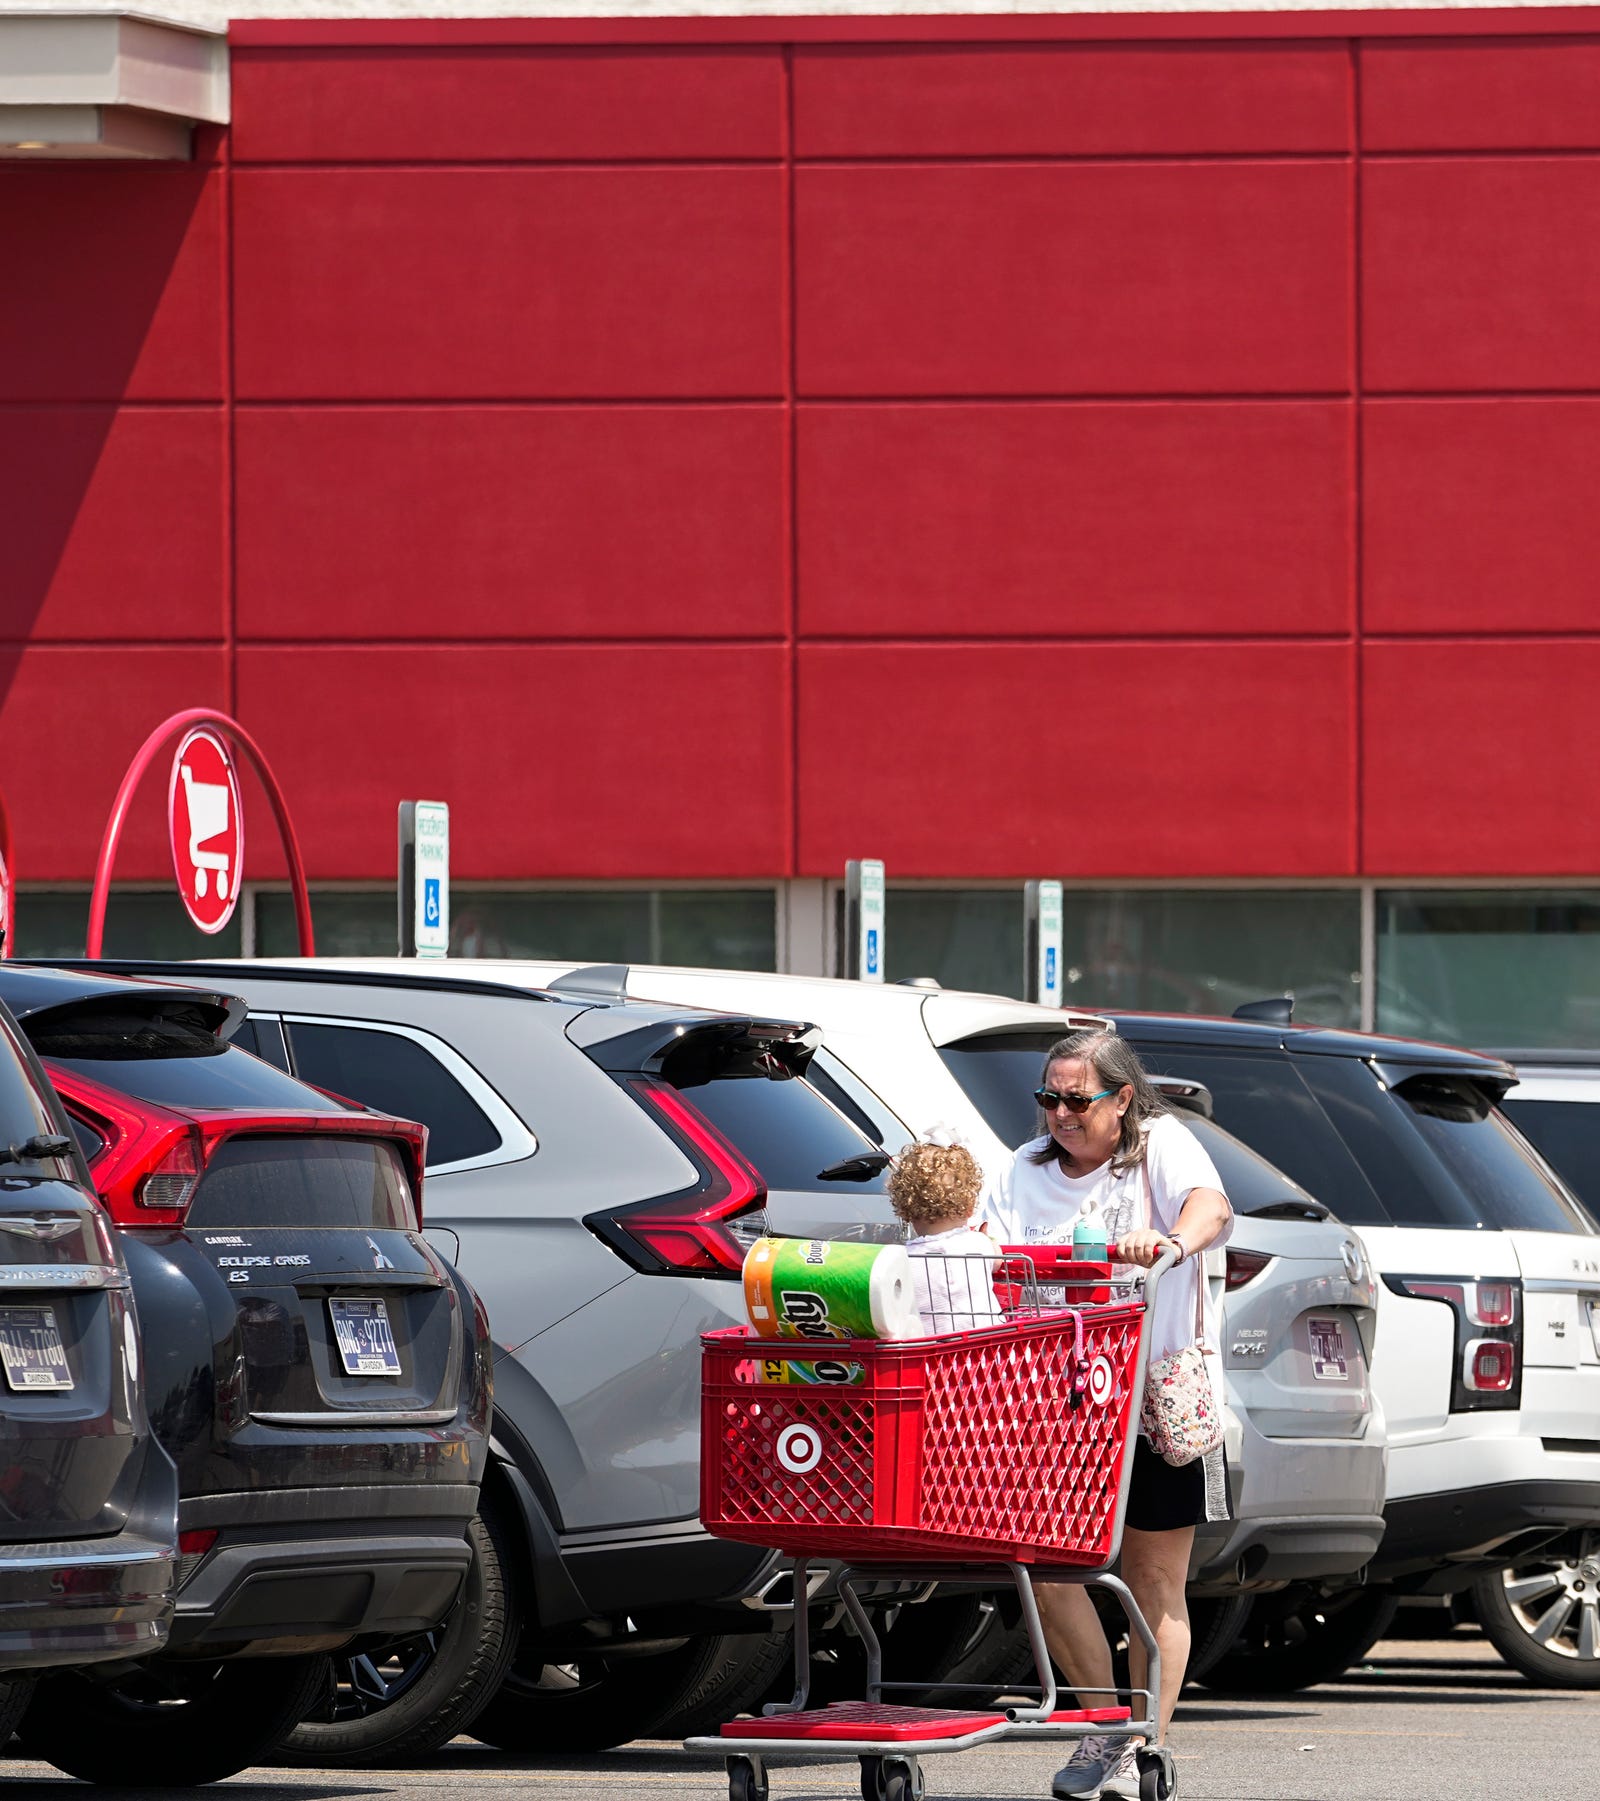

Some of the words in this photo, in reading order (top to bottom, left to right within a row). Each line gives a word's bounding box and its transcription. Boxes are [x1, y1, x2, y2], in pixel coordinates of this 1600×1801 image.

[218, 1256, 272, 1267] ECLIPSE
[274, 1254, 312, 1266] CROSS
[228, 1270, 250, 1282] ES
[364, 1318, 393, 1353] 9277
[1237, 1329, 1267, 1338] NELSON
[1231, 1341, 1267, 1356] CX-5
